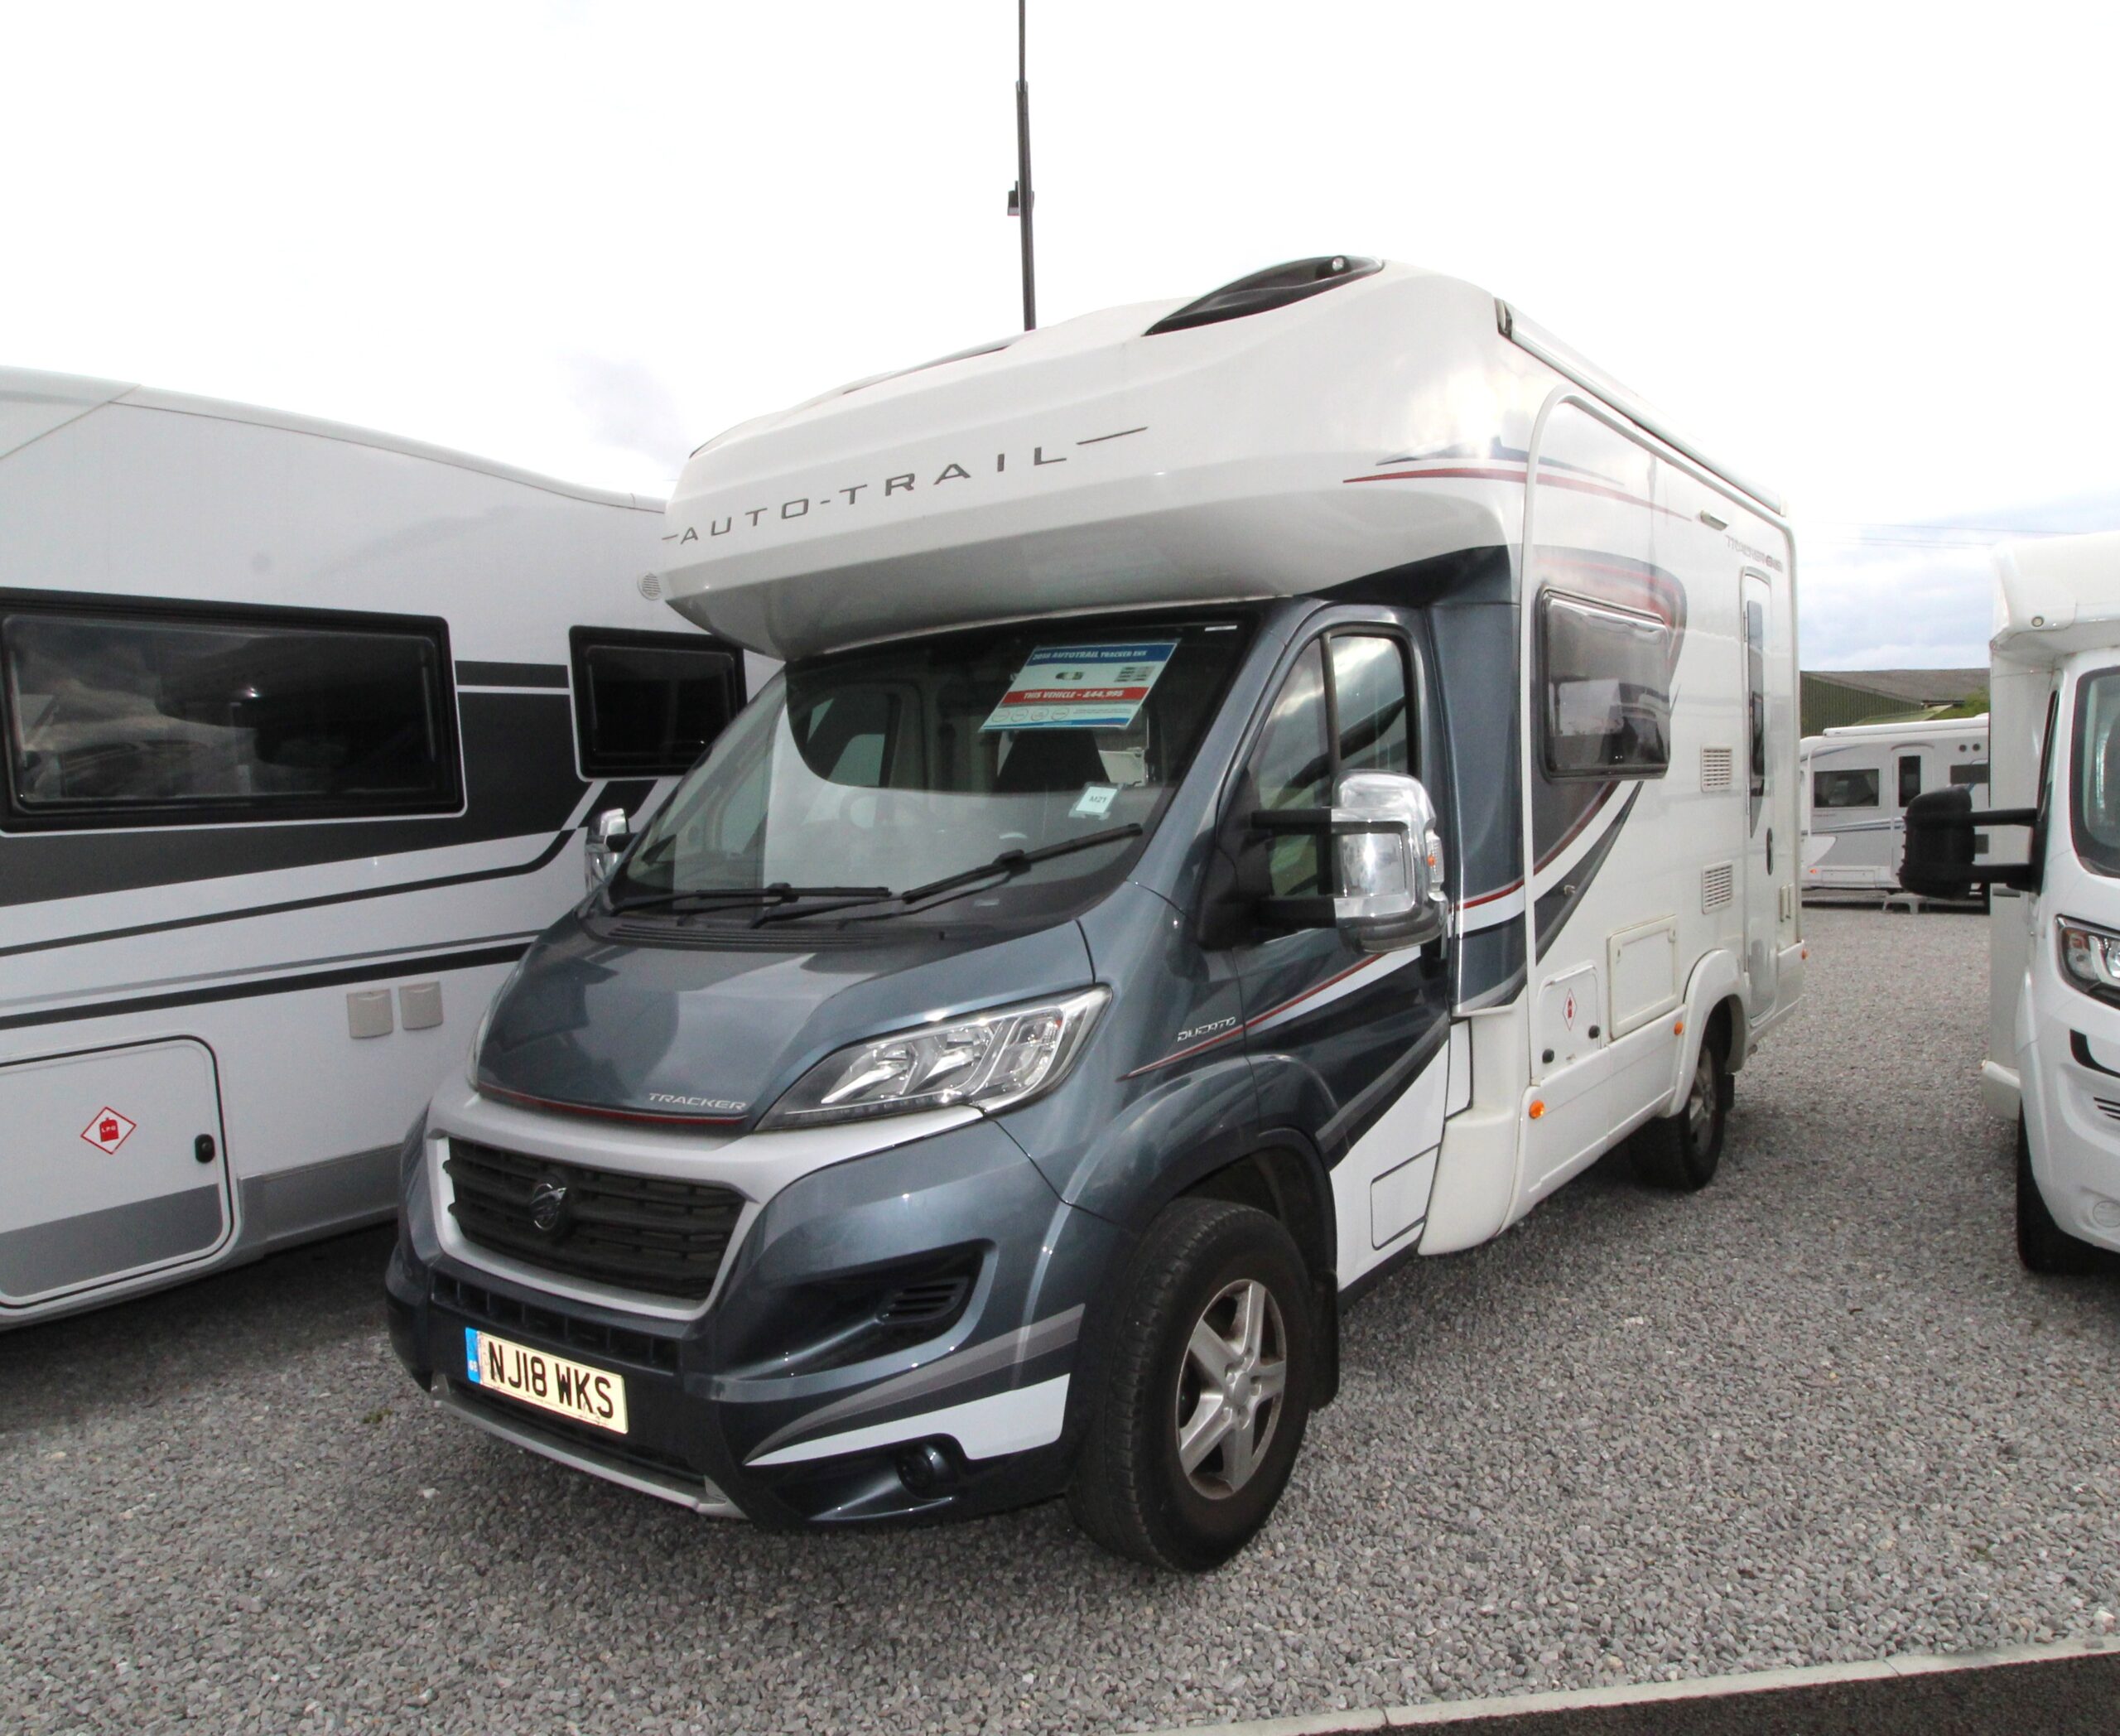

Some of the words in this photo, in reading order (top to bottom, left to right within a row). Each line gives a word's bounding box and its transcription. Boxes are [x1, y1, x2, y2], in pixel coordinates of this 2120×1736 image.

[1052, 650, 1100, 659] AUTOTRAIL
[1024, 691, 1042, 699] THIS
[1043, 690, 1076, 698] VEHICLE
[1178, 1016, 1236, 1042] DUCATO
[649, 1092, 746, 1111] TRACKER
[489, 1341, 547, 1397] NJ18
[555, 1362, 614, 1419] WKS
